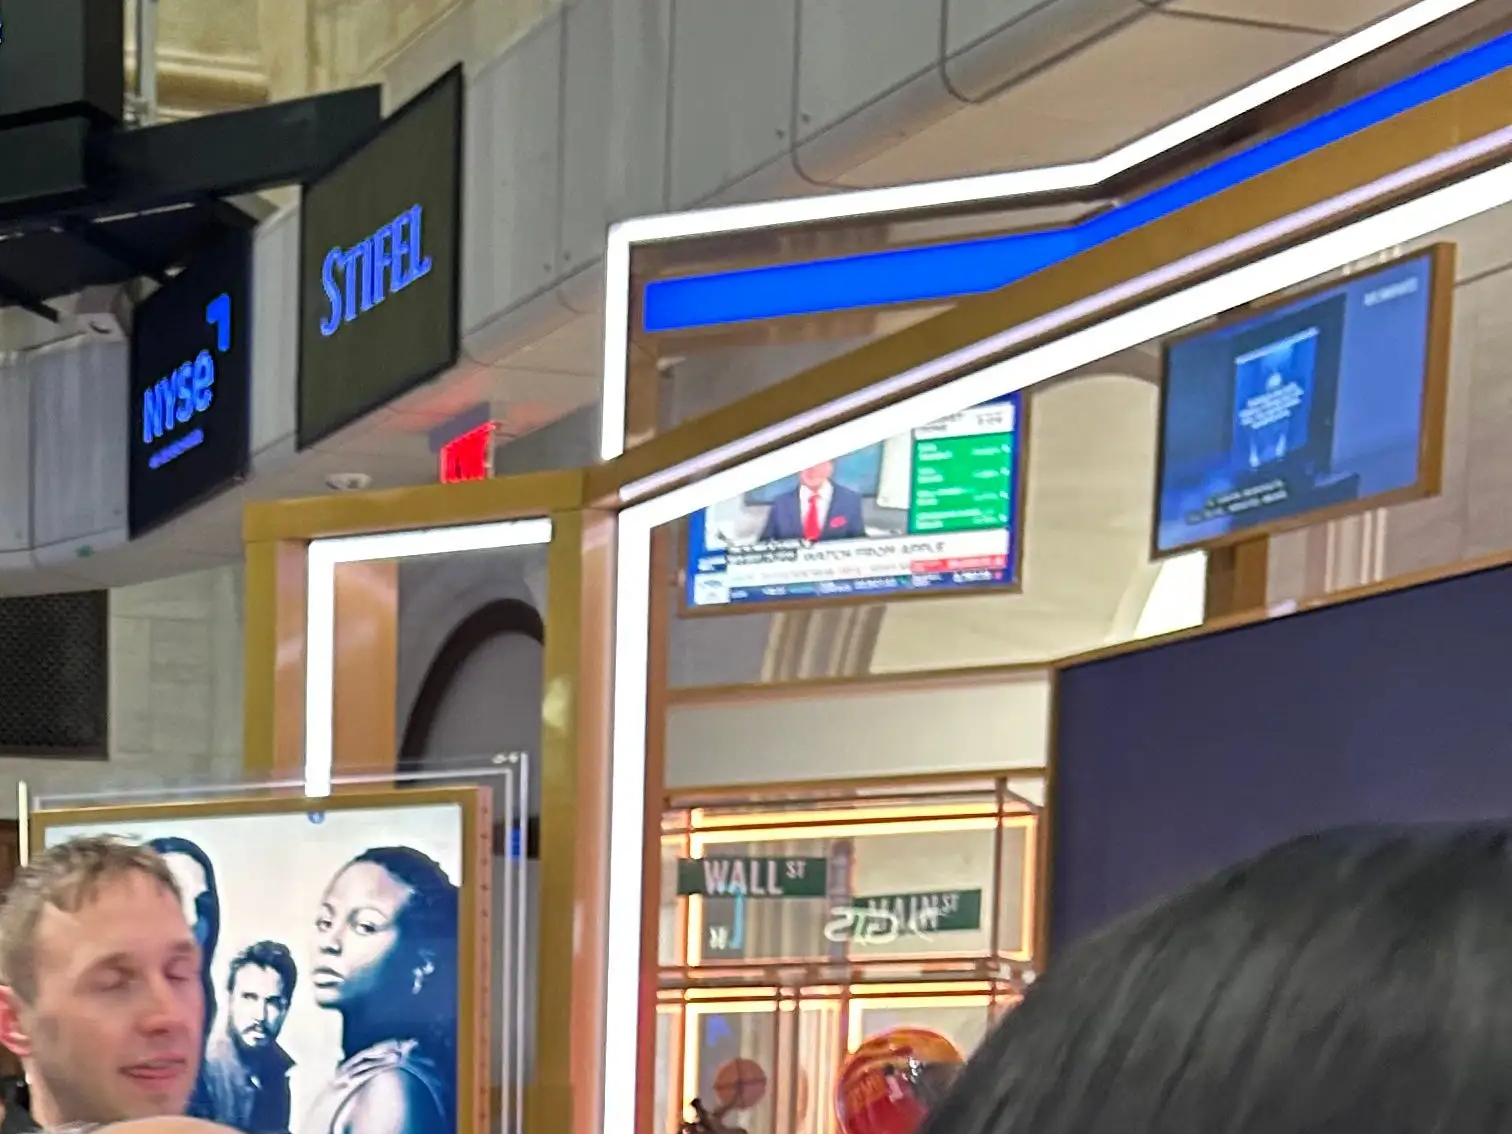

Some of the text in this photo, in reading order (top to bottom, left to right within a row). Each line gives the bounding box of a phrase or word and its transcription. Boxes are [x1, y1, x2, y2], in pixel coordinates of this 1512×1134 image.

[320, 203, 432, 337] STIFEL
[704, 860, 806, 895] WALL ST
